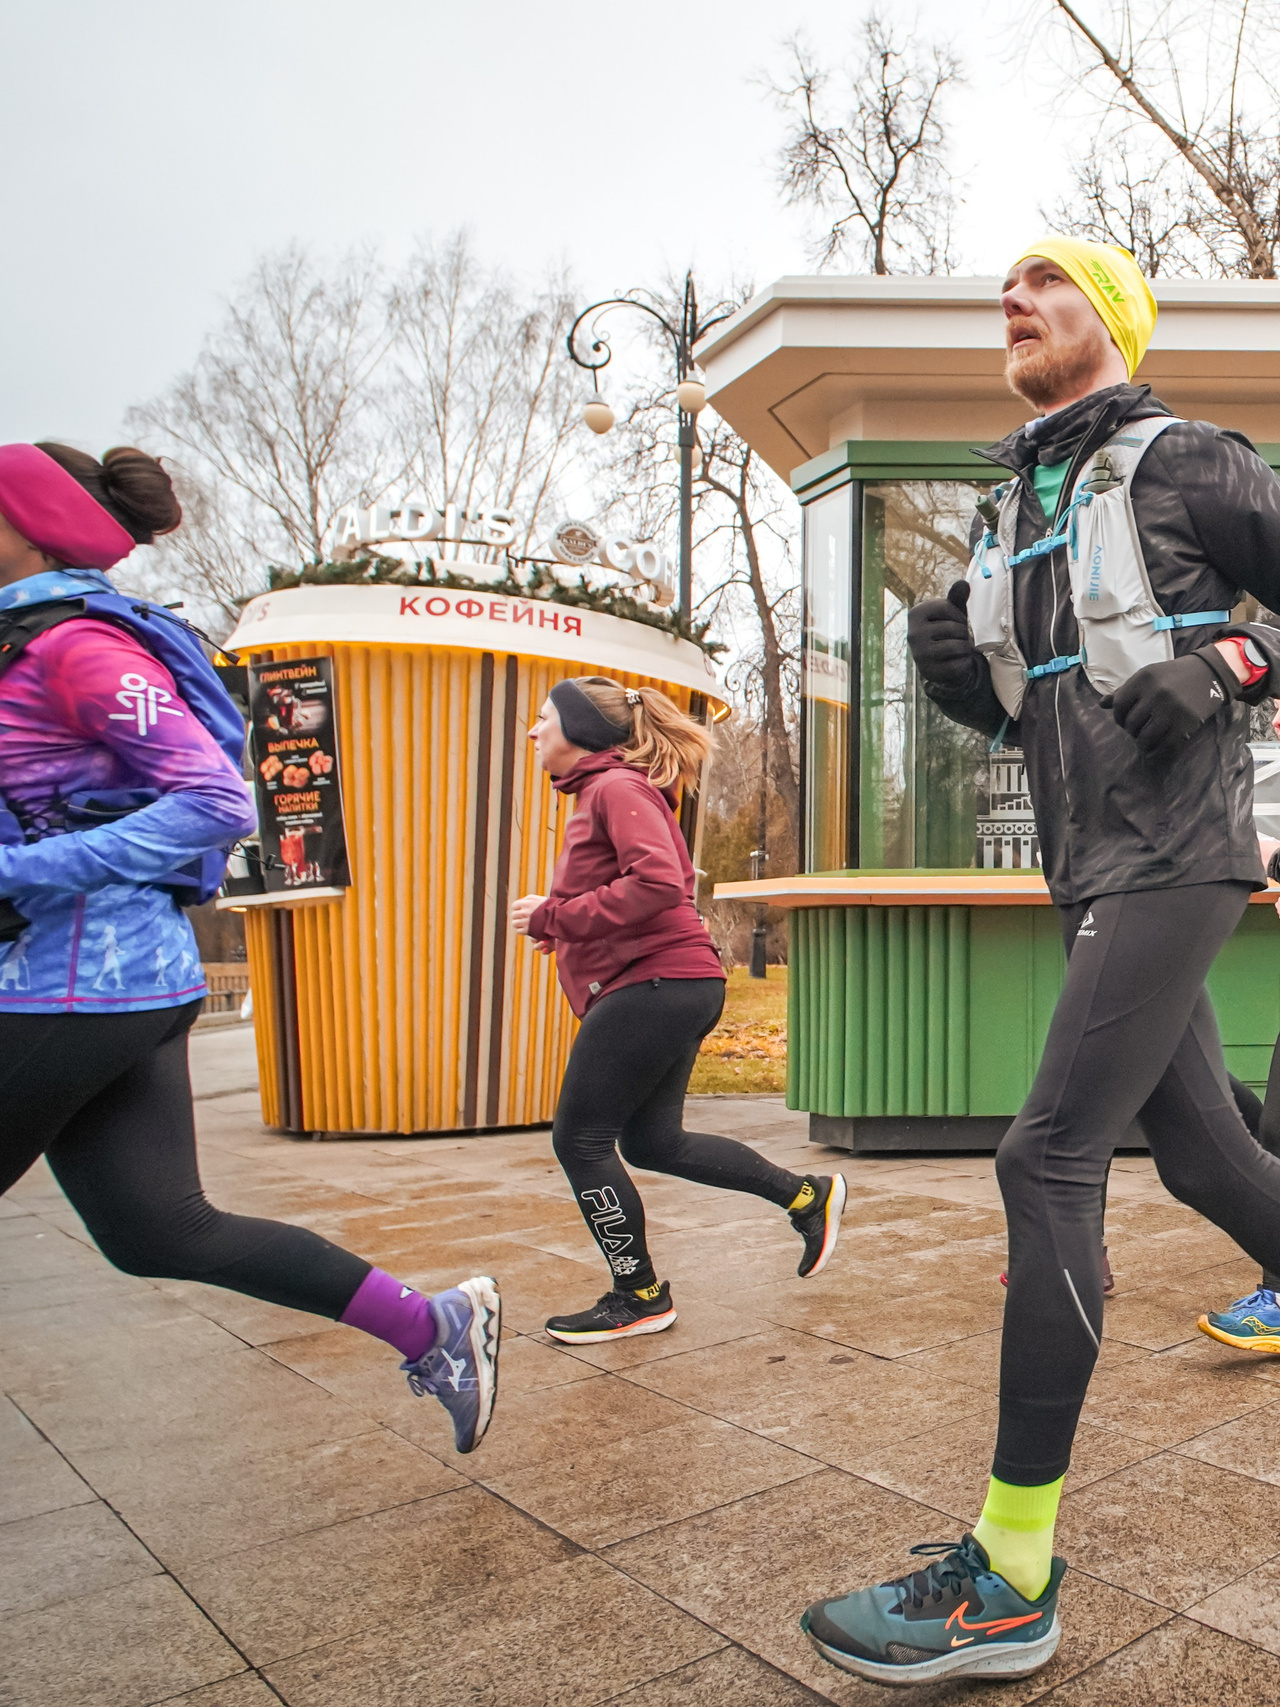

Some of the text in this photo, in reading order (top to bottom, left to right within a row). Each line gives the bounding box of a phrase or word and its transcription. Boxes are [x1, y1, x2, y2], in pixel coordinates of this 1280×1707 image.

[399, 596, 583, 637] КОФЕЙНЯ
[259, 664, 318, 683] ГЛИНТВЕЙН
[267, 737, 320, 753] ВЫПЕЧКА
[273, 790, 322, 806] ГОРЯЧИЕ
[278, 802, 319, 814] НАПИТКИ
[580, 1185, 634, 1255] FILA
